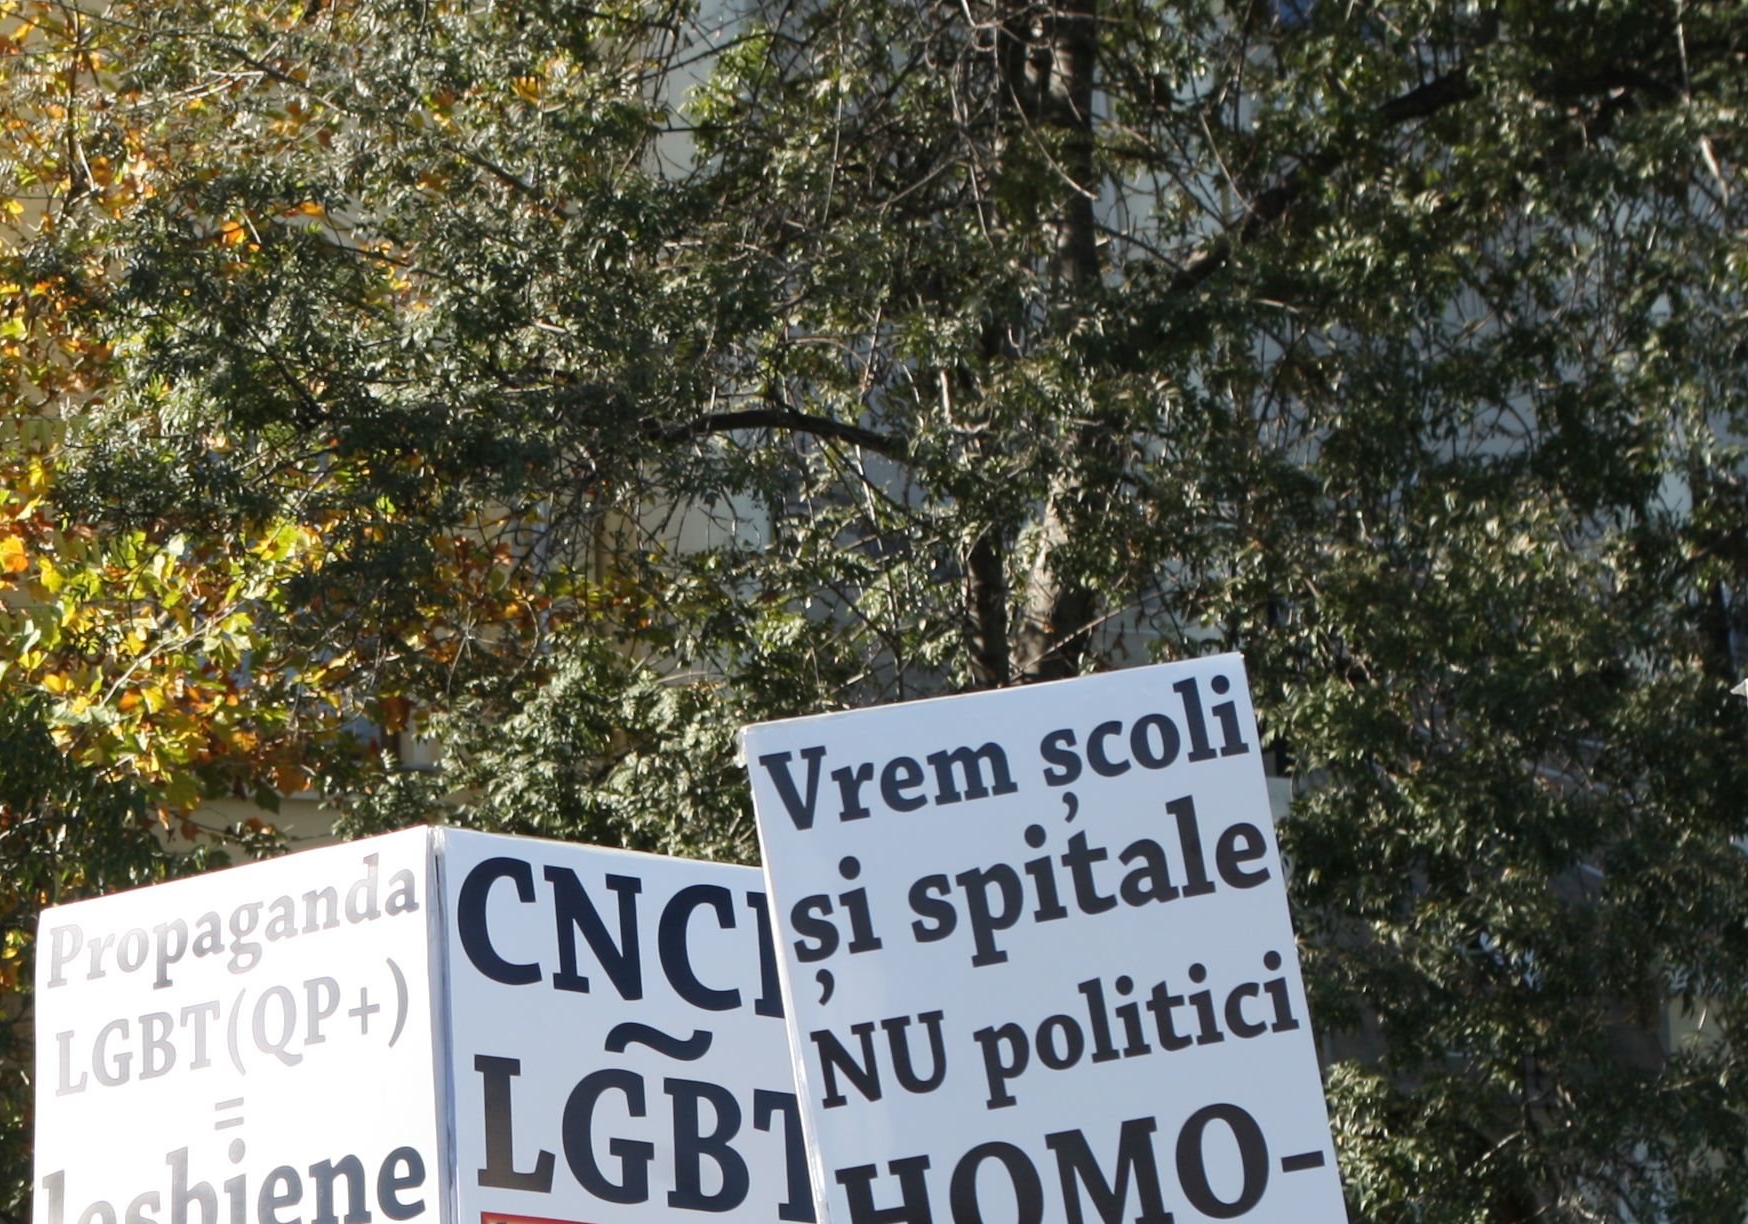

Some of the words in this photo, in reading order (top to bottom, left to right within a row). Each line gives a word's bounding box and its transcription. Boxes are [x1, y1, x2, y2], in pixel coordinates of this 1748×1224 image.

[759, 739, 1017, 831] Vrem
[1040, 674, 1249, 823] școli
[46, 852, 419, 990] Propaganda
[790, 855, 882, 1005] și
[908, 795, 1271, 967] spitale
[56, 957, 409, 1097] LGBT(QP+)
[810, 1009, 947, 1109] NU
[973, 950, 1299, 1110] politici
[474, 1053, 817, 1224] LGBT
